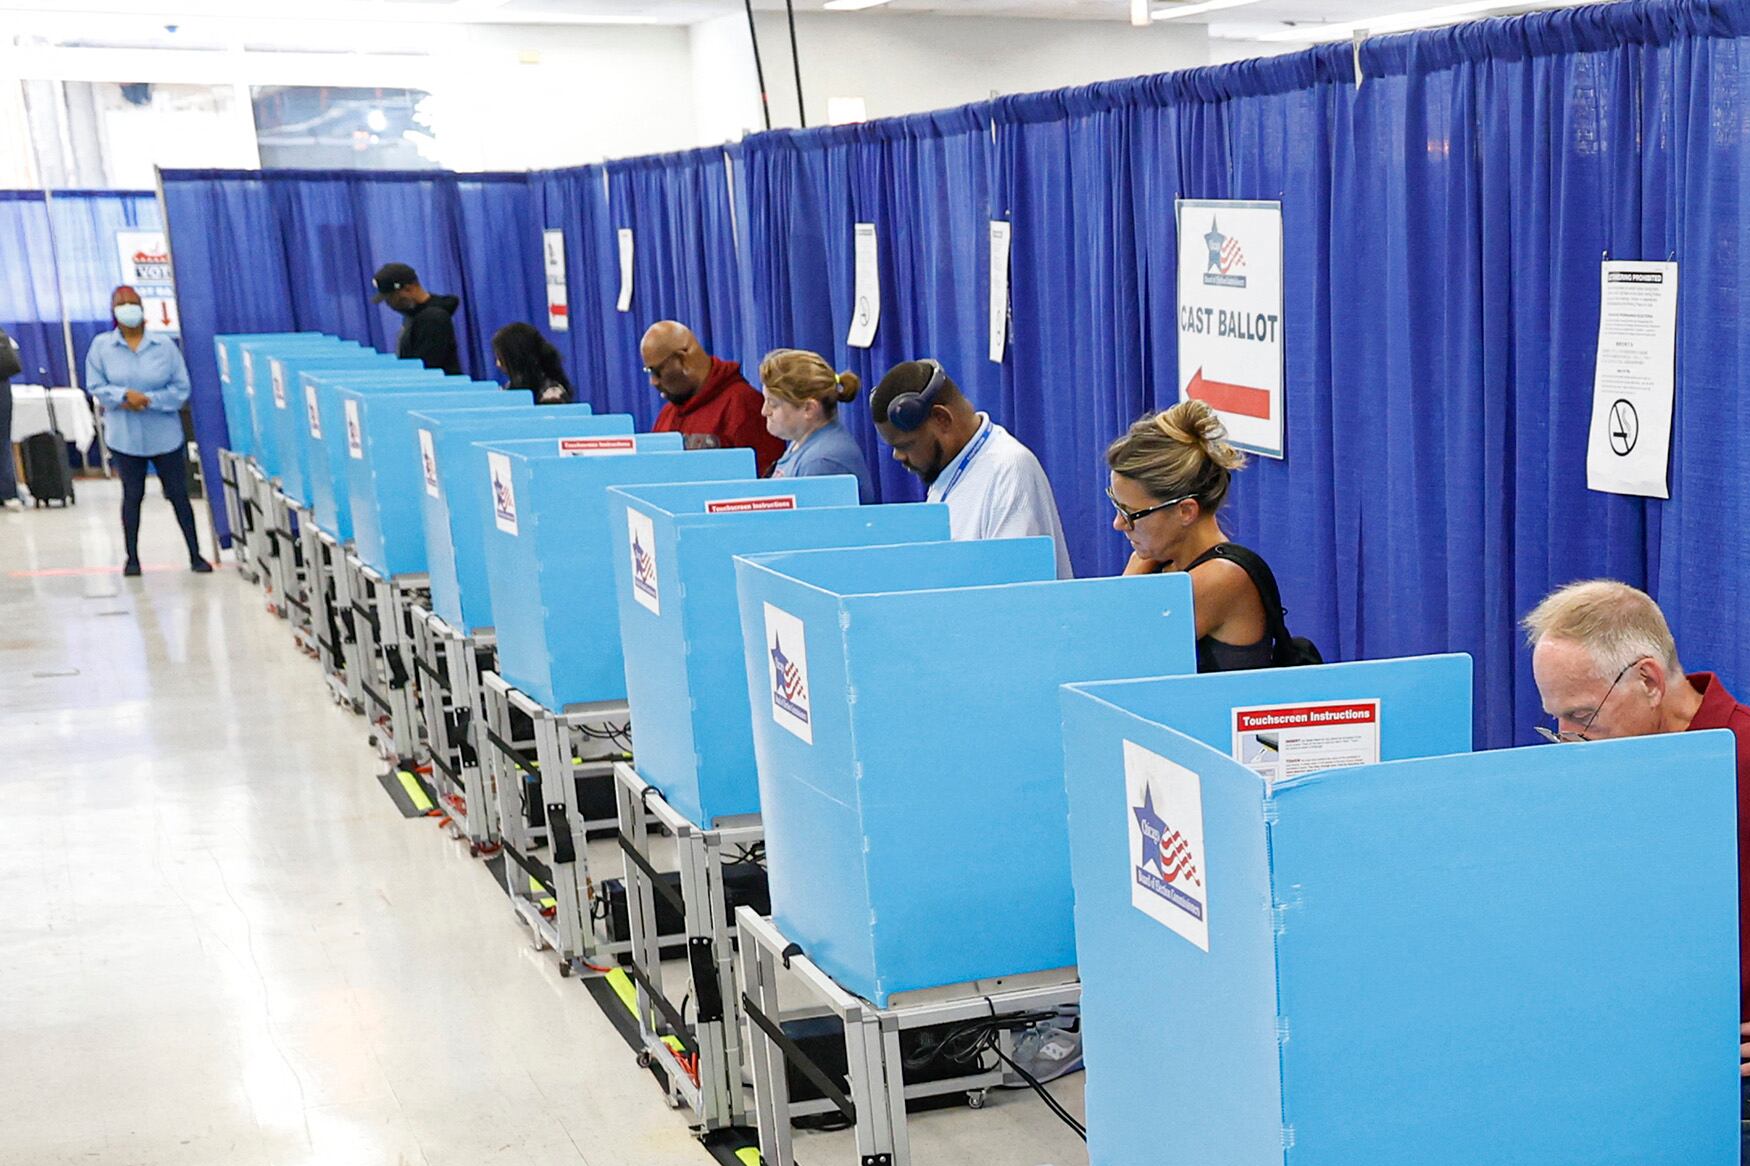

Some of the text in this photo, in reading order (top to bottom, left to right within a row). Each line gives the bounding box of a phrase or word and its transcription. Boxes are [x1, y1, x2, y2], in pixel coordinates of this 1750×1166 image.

[1181, 305, 1278, 343] CAST BALLOT
[752, 501, 790, 509] Instructions
[1242, 709, 1371, 727] Touchscreen Instructions
